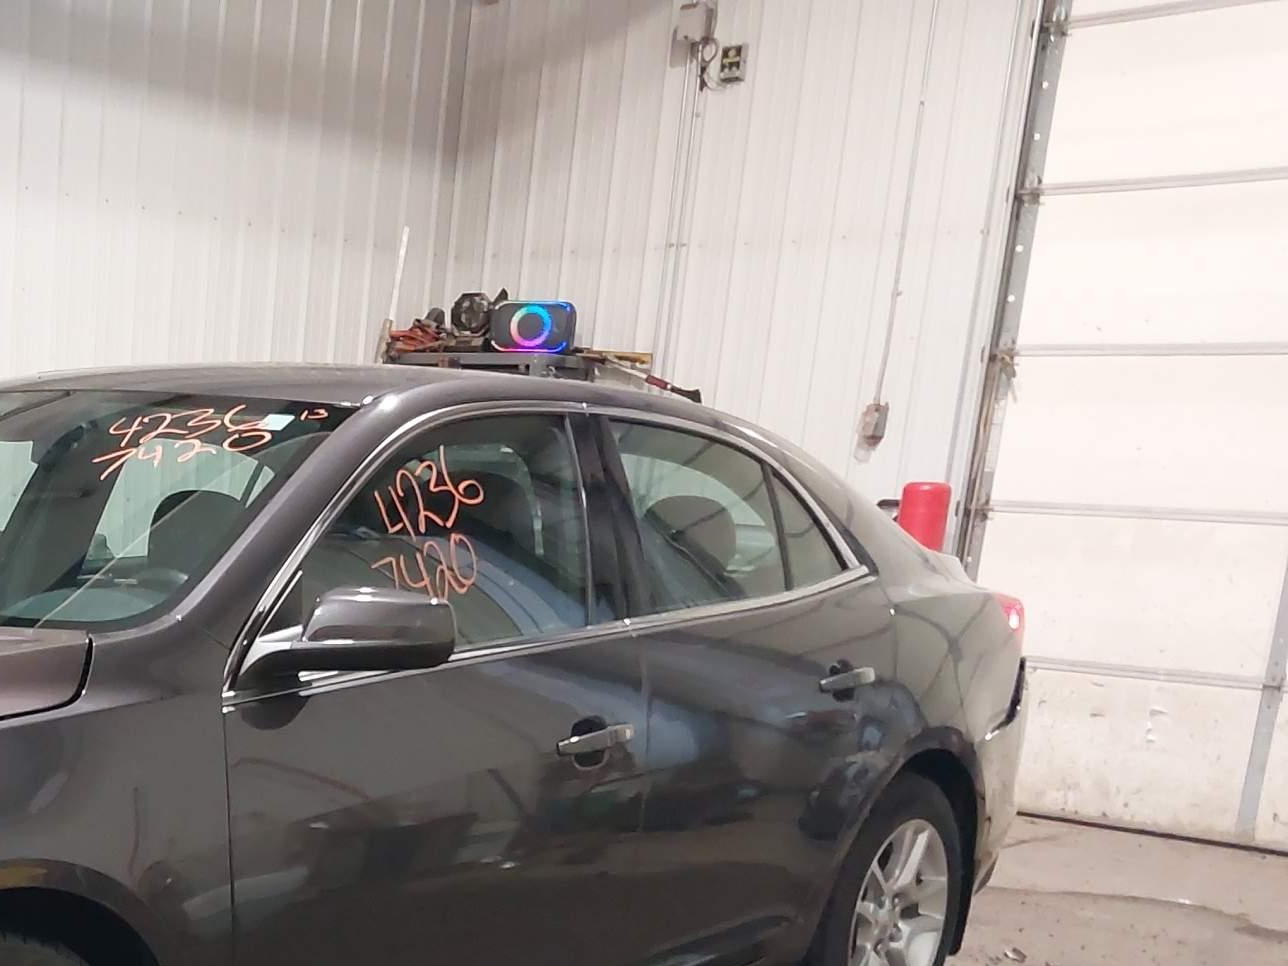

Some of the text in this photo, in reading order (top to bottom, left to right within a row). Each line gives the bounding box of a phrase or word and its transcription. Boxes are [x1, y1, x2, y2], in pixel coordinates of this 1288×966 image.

[109, 404, 268, 447] 4236
[92, 431, 273, 481] 7420
[374, 445, 485, 542] 4236
[371, 533, 478, 602] 7420
